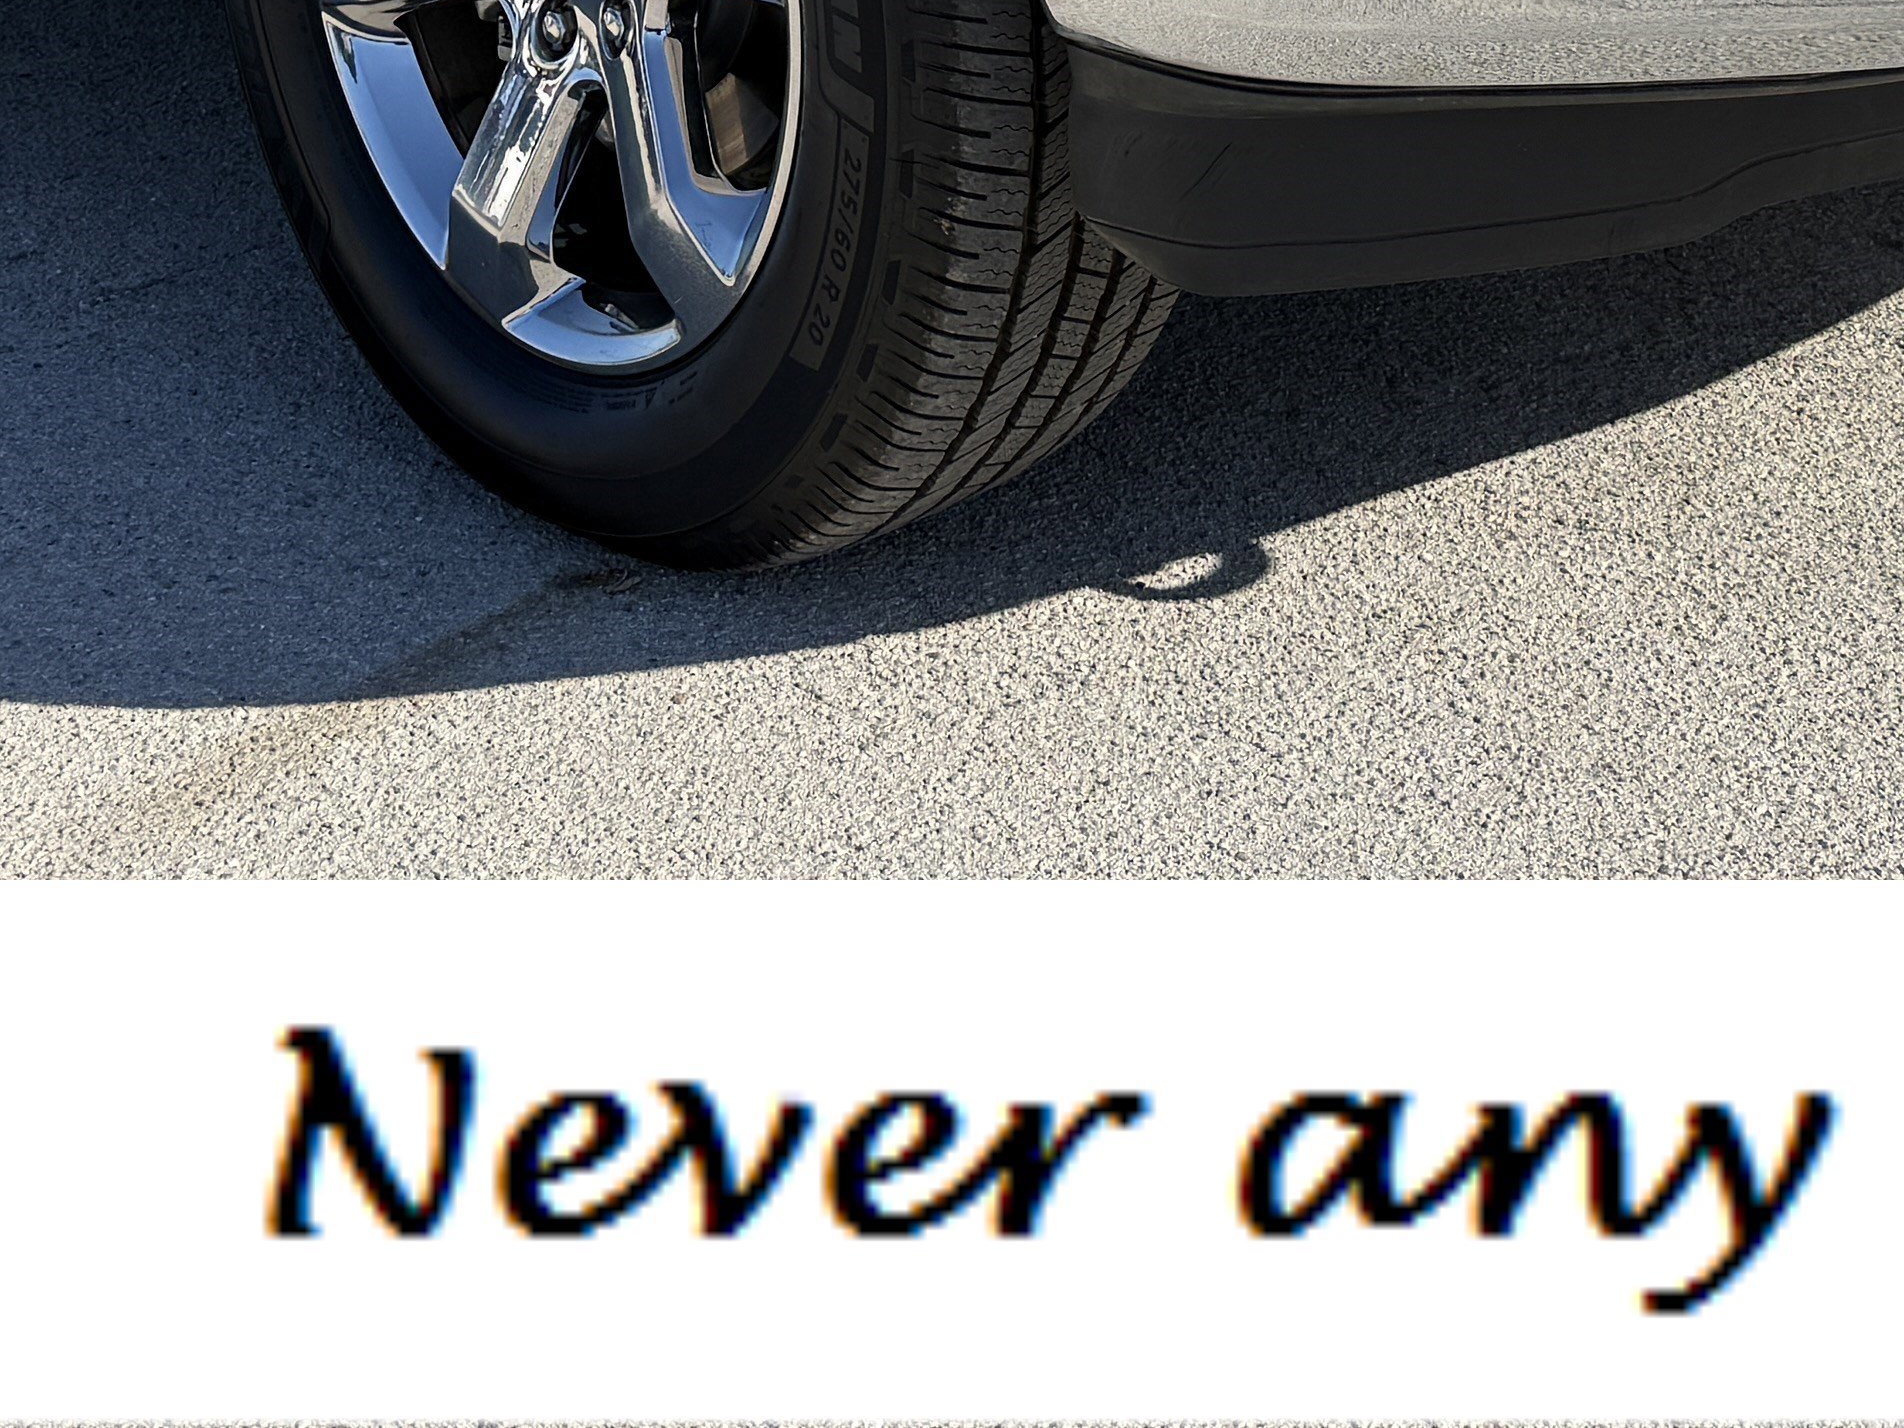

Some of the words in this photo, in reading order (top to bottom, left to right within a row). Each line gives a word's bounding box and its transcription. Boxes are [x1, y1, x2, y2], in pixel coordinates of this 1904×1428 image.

[830, 147, 863, 273] 275/60
[821, 273, 841, 303] R
[808, 303, 831, 347] 20
